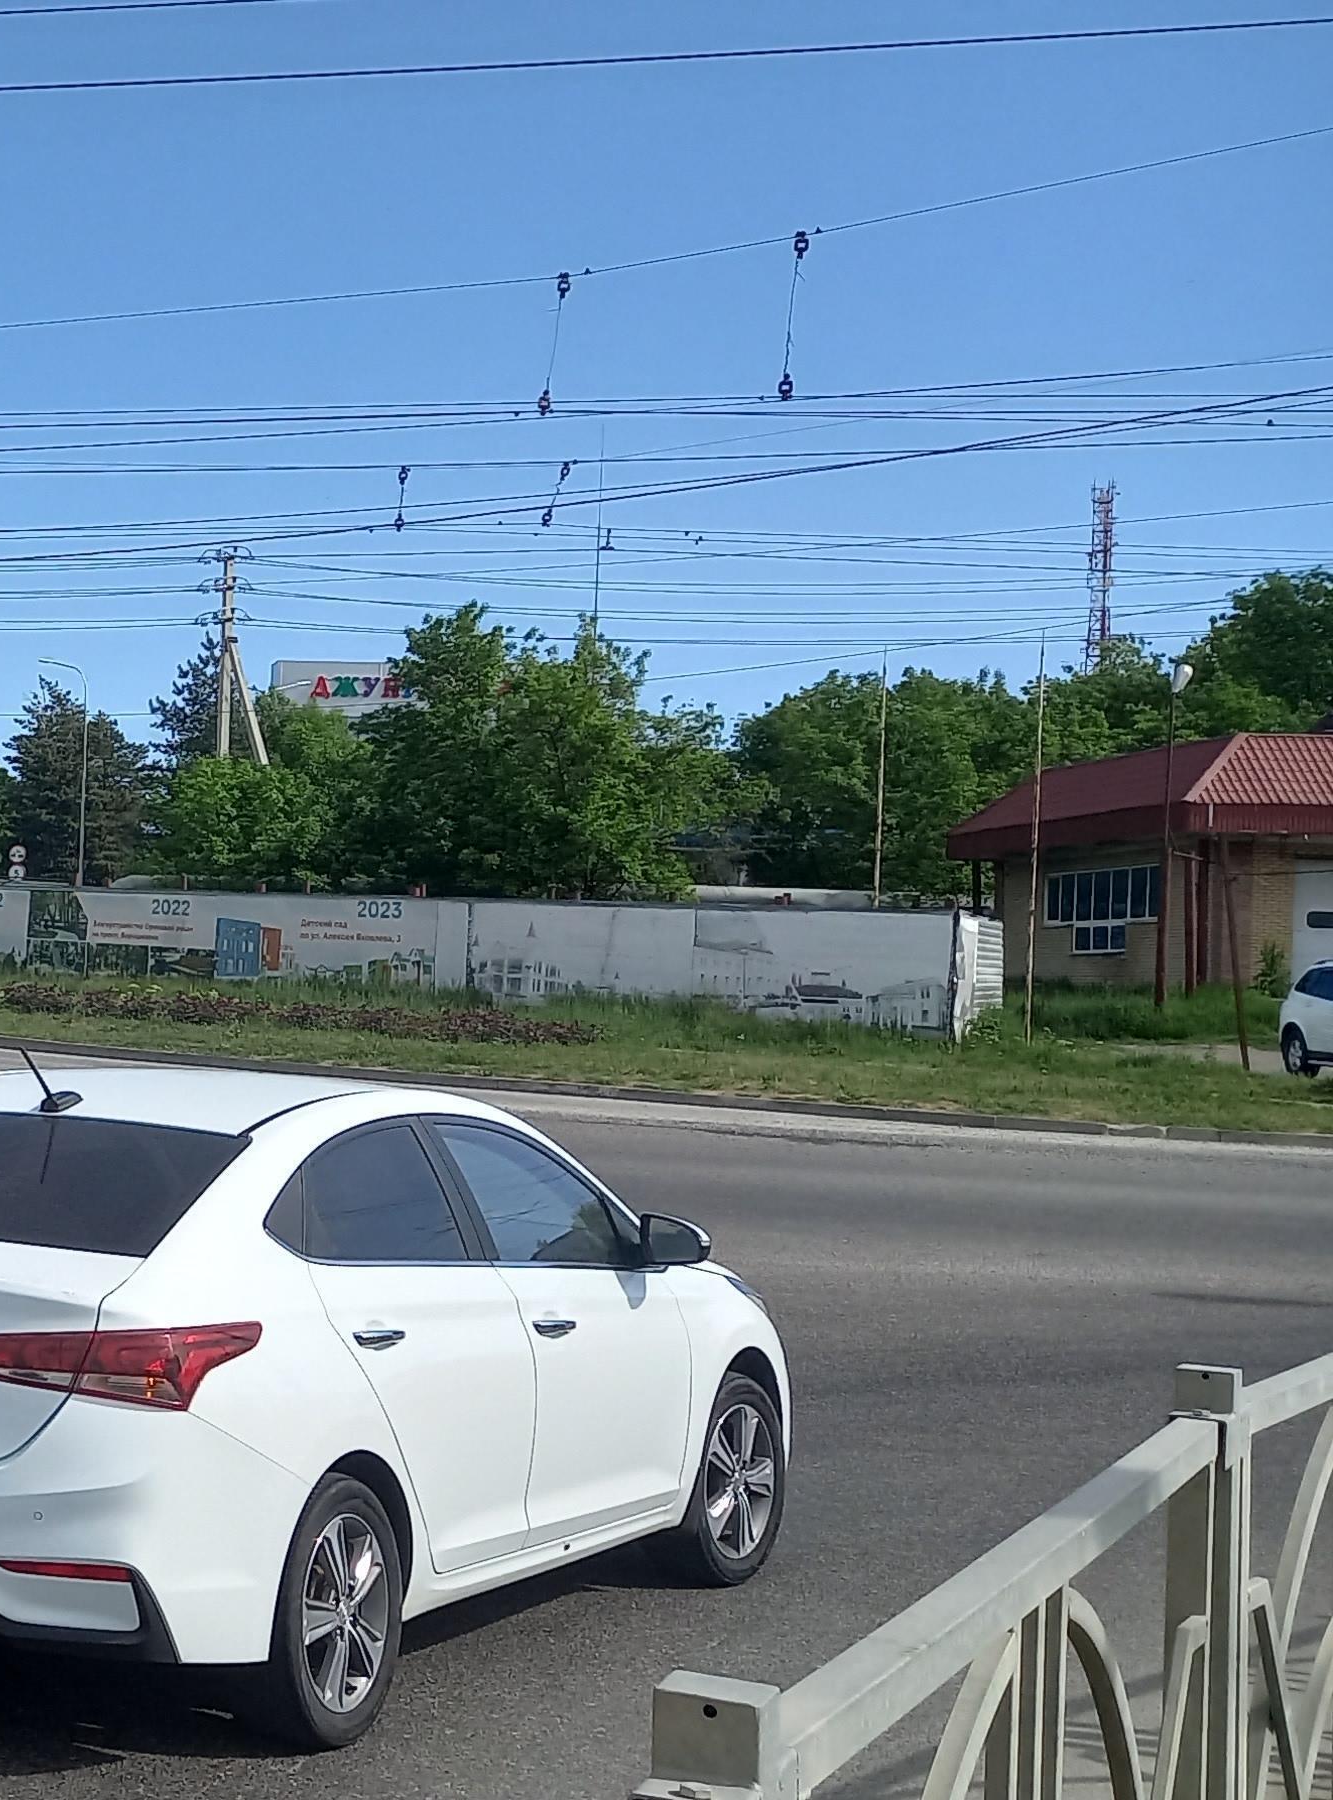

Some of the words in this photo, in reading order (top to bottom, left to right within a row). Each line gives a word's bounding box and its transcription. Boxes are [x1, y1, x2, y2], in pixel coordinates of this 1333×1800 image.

[310, 675, 413, 699] ДЖУН
[151, 899, 191, 916] 2022
[356, 900, 403, 919] 2023
